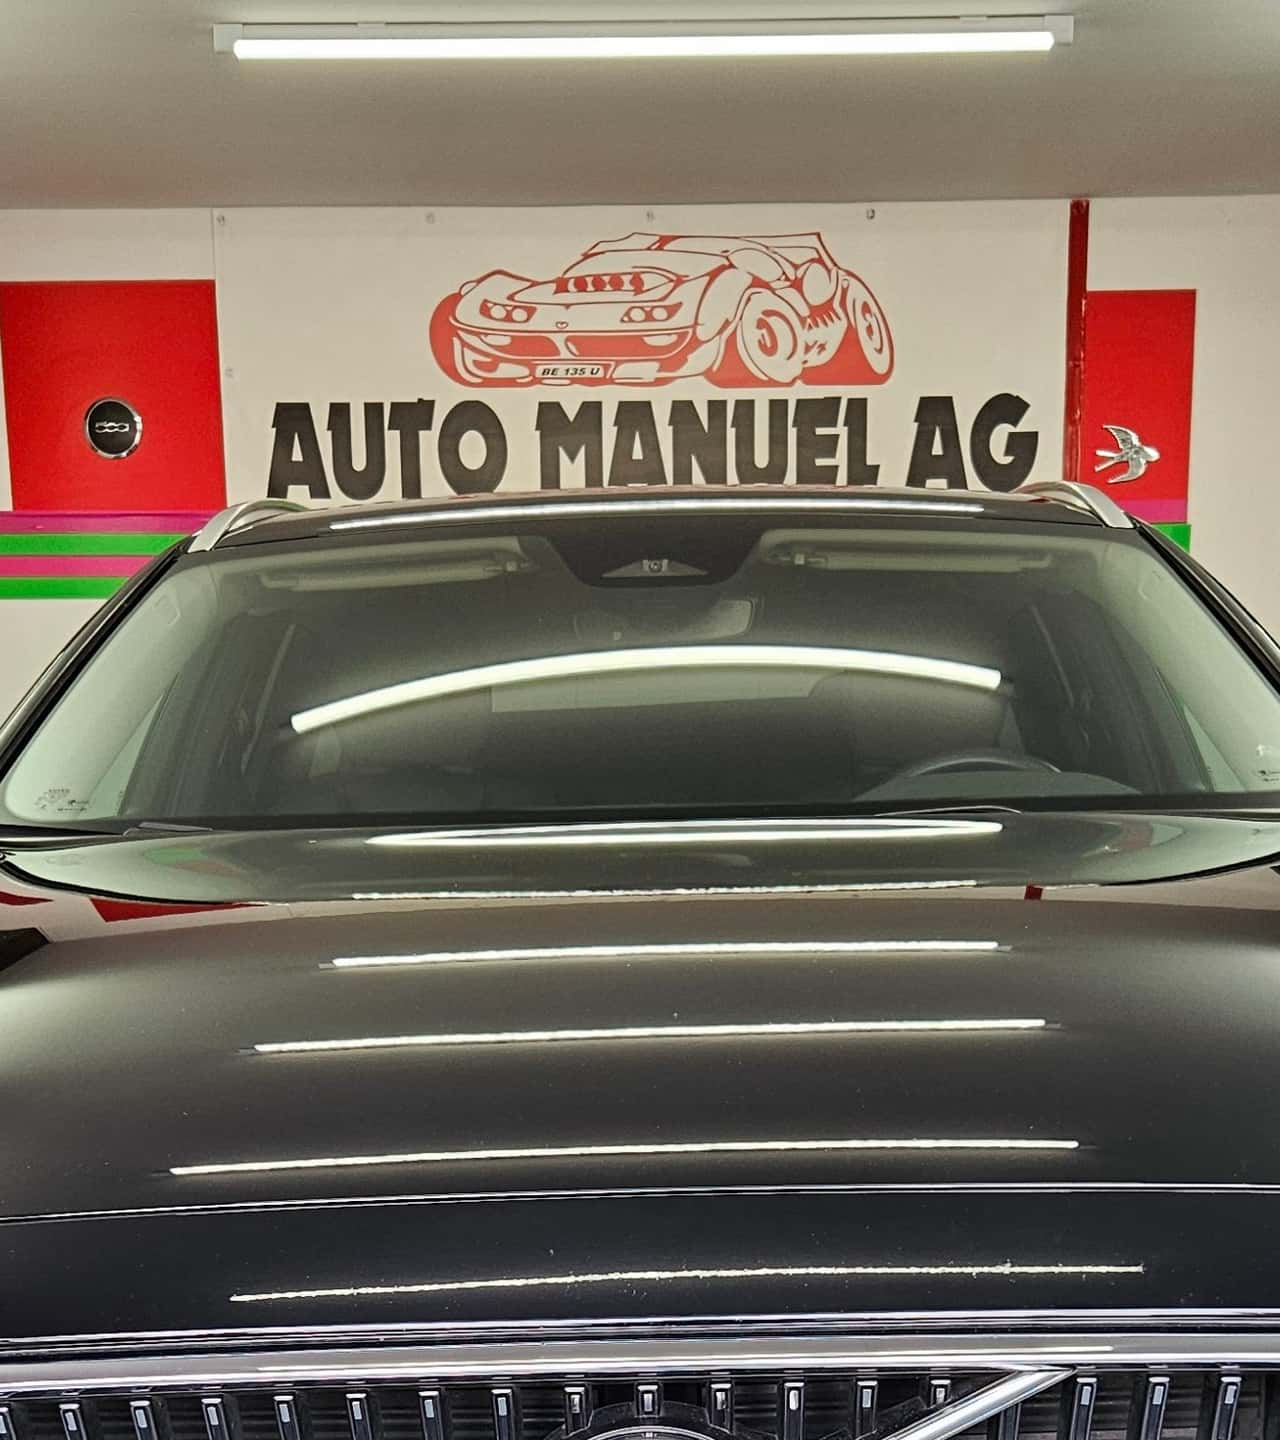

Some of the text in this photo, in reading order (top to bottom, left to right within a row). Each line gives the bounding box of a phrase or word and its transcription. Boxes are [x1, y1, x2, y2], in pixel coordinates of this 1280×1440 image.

[541, 368, 559, 376] BE
[564, 368, 586, 376] 135
[267, 392, 1039, 500] AUTO MANUEL AG
